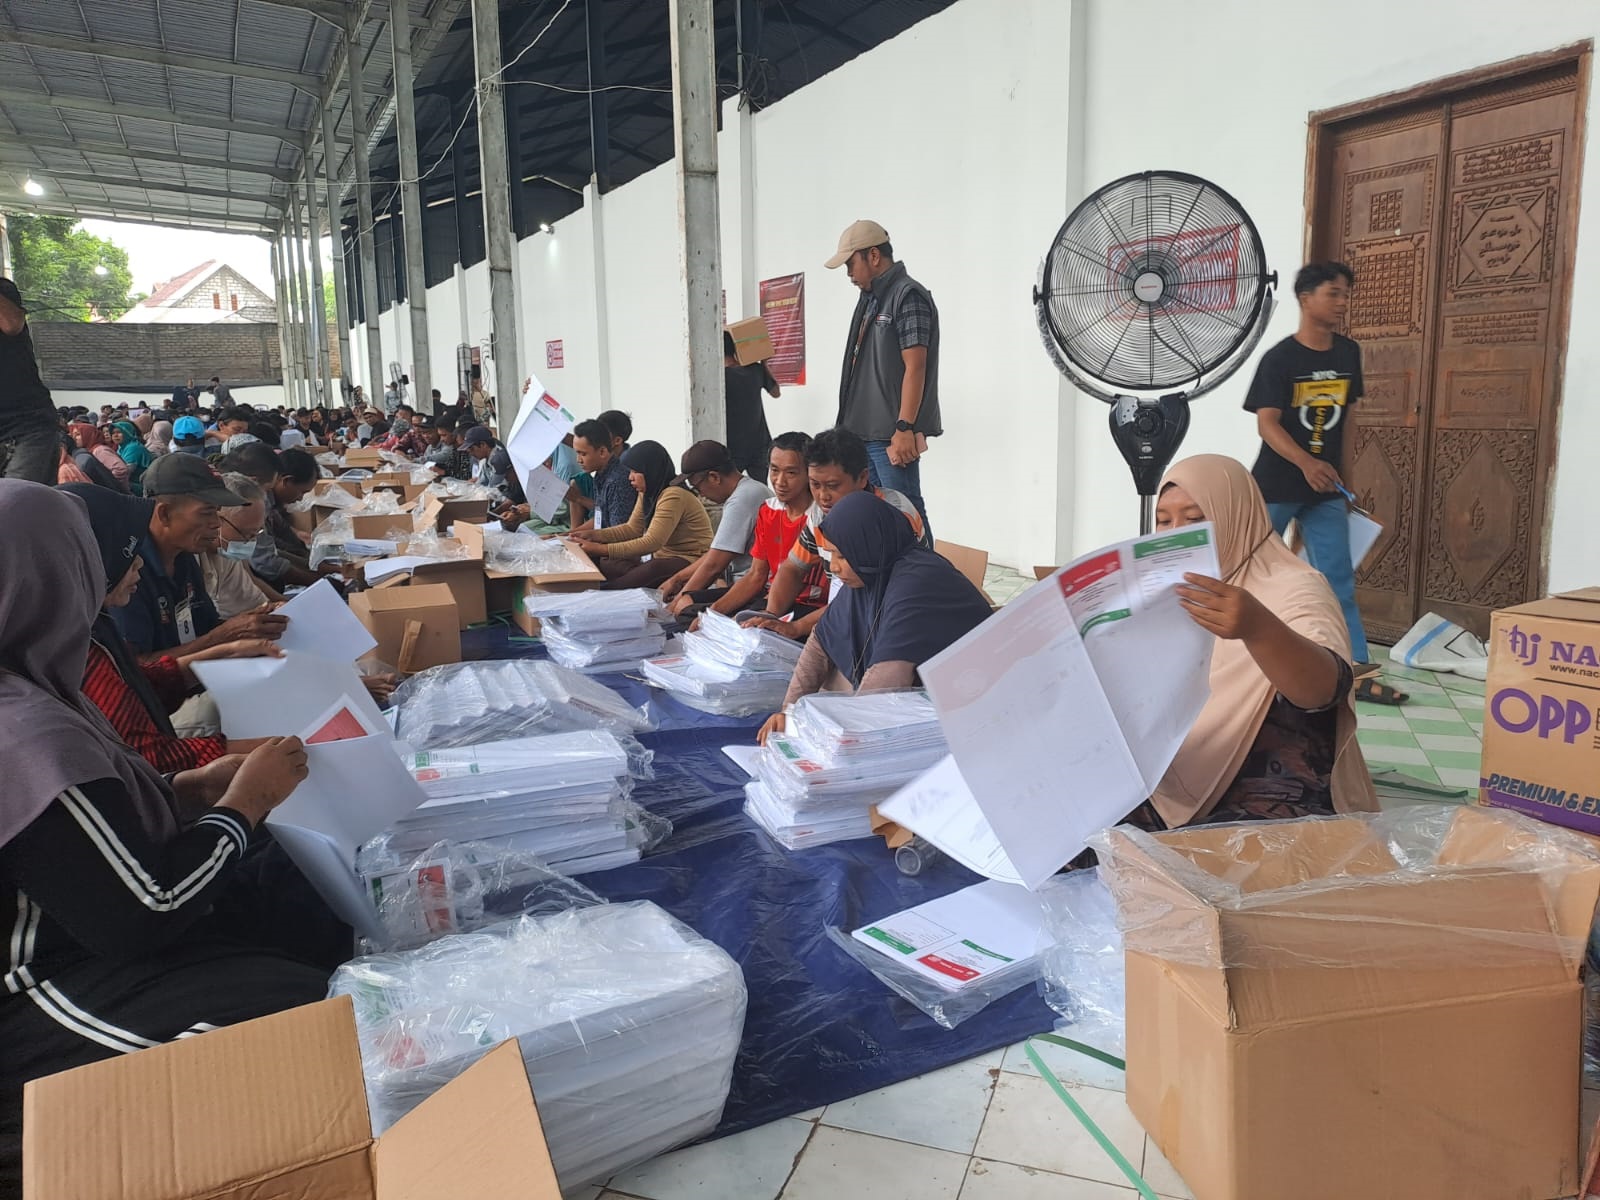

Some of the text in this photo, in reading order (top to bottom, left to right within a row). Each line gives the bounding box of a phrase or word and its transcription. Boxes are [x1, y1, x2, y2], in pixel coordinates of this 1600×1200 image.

[1549, 641, 1600, 667] NA
[1491, 688, 1592, 744] OPP
[1487, 773, 1566, 807] PREMIUM
